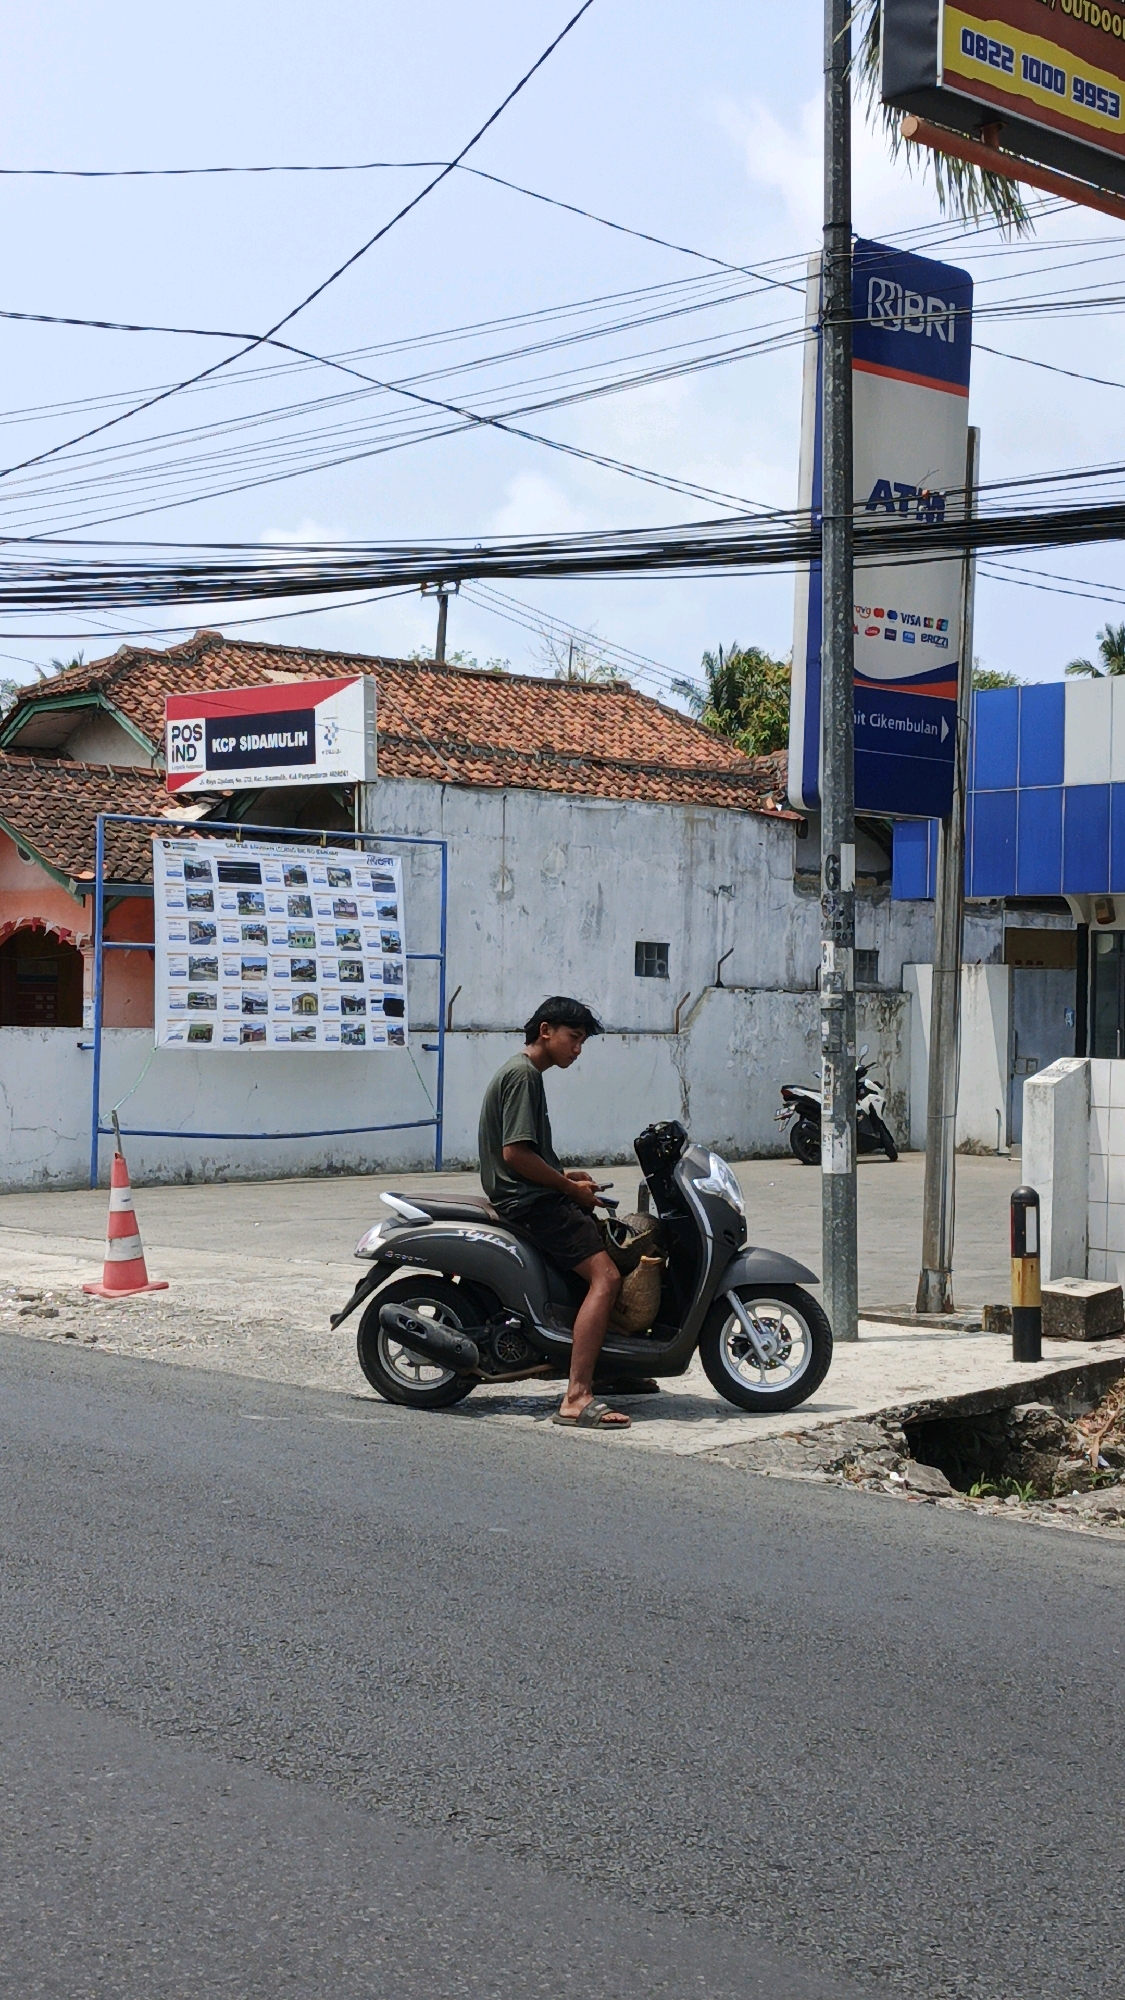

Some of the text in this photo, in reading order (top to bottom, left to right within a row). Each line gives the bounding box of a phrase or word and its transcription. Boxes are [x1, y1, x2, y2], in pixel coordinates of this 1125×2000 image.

[1061, 0, 1125, 40] OUTDOO
[961, 28, 1121, 119] 0822 1000 9953
[865, 478, 946, 524] ATM
[899, 612, 921, 627] VISA
[171, 723, 203, 743] POS
[869, 713, 938, 735] Cikembulan
[211, 731, 308, 753] KCP SIDAMULIH
